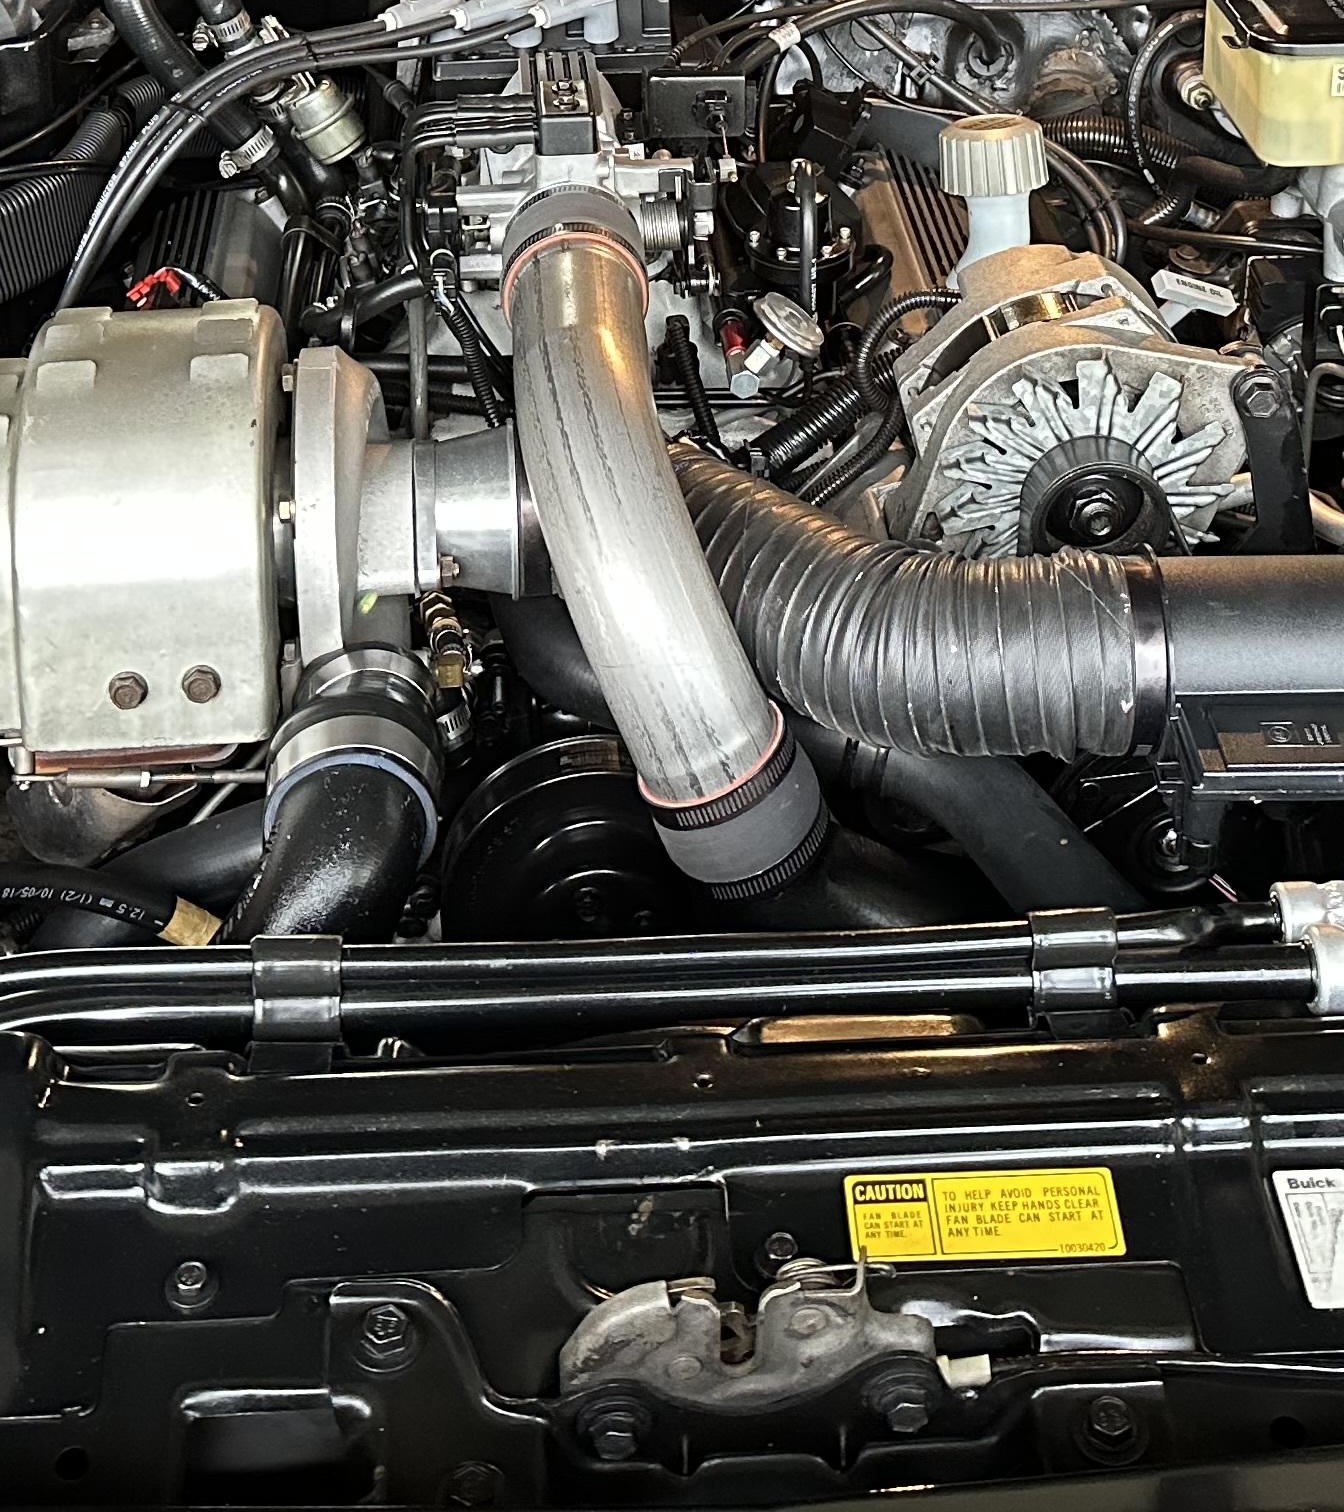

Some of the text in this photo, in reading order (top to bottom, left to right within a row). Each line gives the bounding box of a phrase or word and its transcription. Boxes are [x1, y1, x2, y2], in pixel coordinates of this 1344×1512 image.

[88, 173, 119, 227] CONDUCTOR
[119, 140, 140, 168] SPARK
[141, 114, 160, 135] PLUG
[1, 886, 54, 900] 10/05/18
[60, 888, 94, 905] (1/2)
[115, 903, 147, 921] 12.5
[1287, 1177, 1337, 1189] Buick
[855, 1183, 925, 1202] CAUTION
[942, 1185, 1101, 1201] TO HELP AVOID PERSONAL
[945, 1199, 1099, 1214] INJURY KEEP HANDS CLEAR
[863, 1211, 922, 1220] FAN BLADE
[946, 1209, 1104, 1226] FAN BLADE CAN START AT
[864, 1219, 924, 1229] CAN START AT
[865, 1230, 882, 1239] ANY
[948, 1226, 970, 1237] ANY
[1059, 1242, 1106, 1253] 10030420
